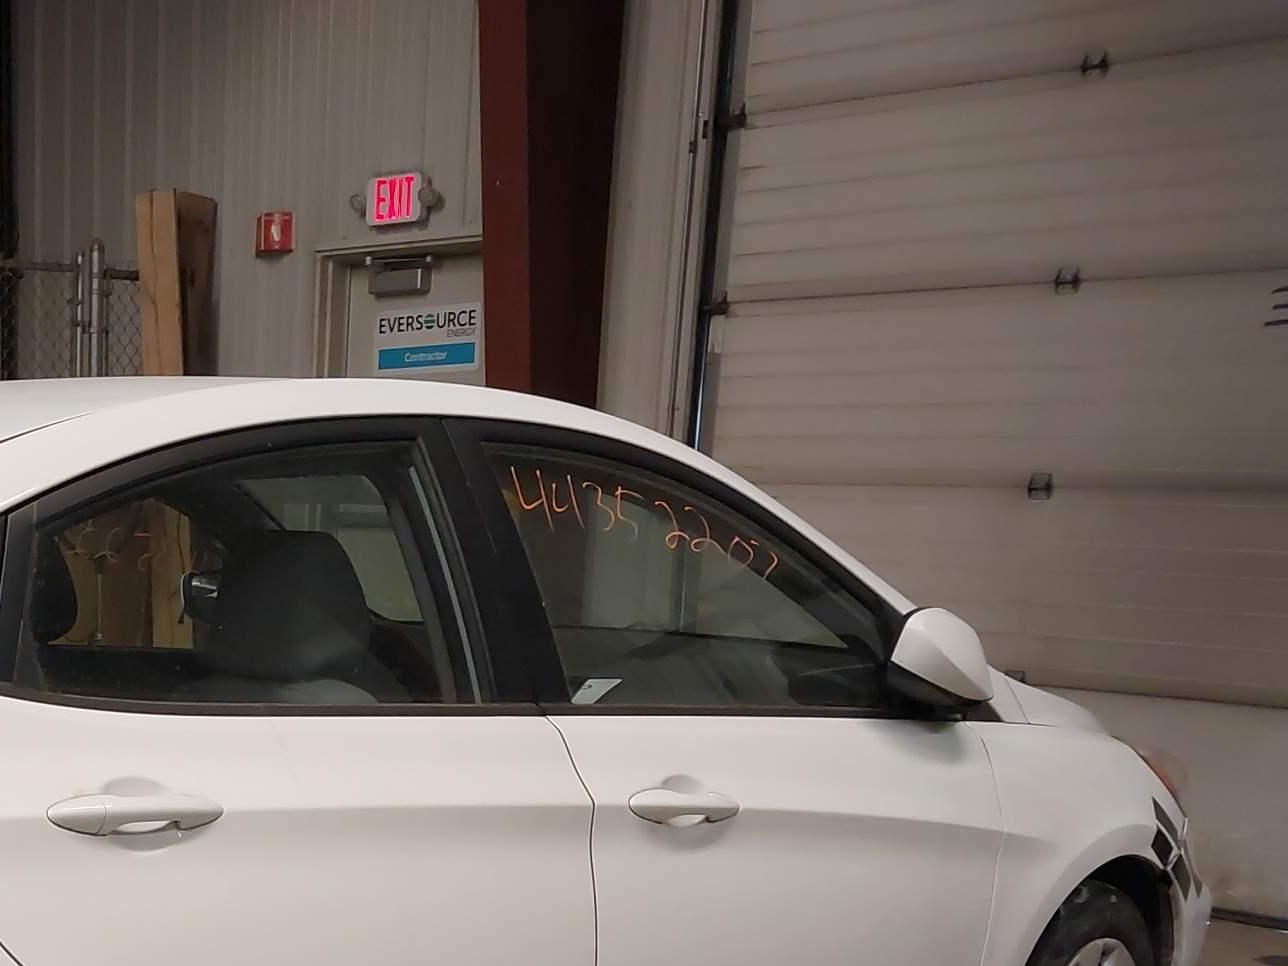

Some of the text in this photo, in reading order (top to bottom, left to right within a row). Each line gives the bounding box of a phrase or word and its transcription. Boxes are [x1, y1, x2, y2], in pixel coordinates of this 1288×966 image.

[375, 176, 414, 221] EXIT
[378, 309, 477, 335] EVERSOURCE
[404, 351, 448, 363] Contractor
